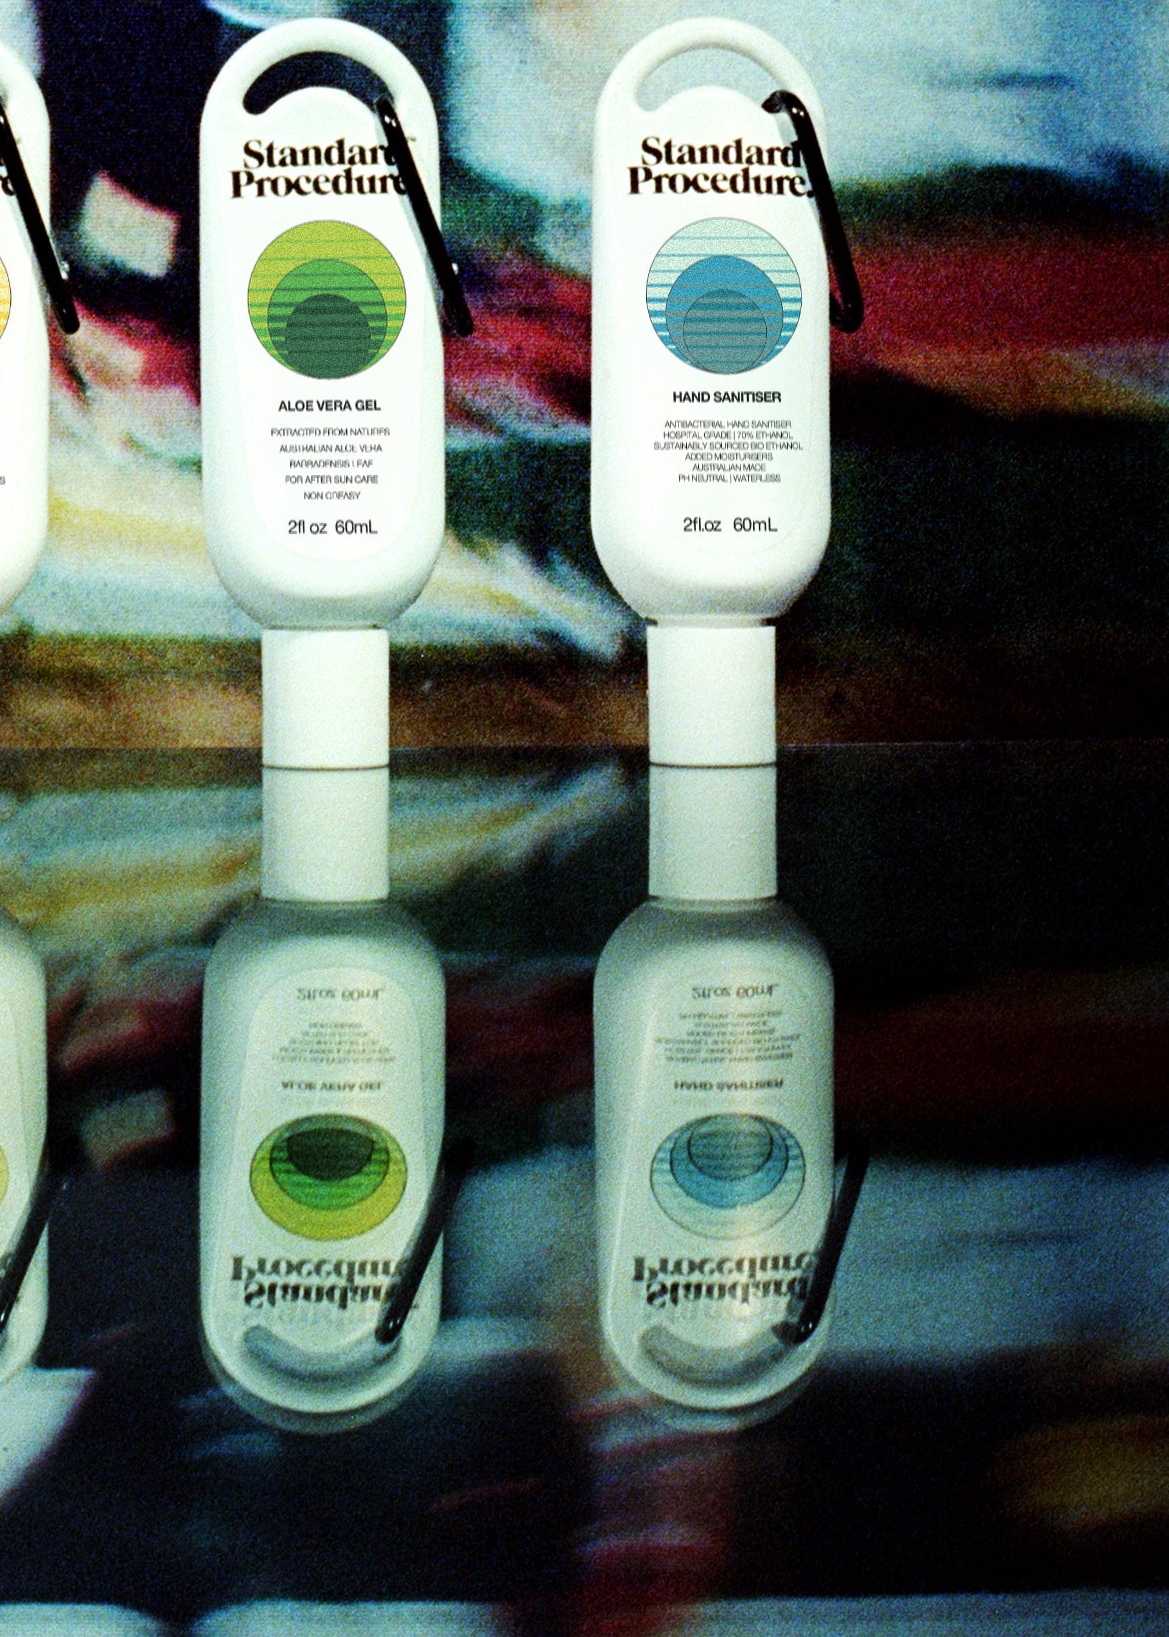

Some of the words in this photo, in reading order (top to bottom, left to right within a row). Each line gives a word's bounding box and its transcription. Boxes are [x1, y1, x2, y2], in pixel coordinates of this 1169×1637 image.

[641, 136, 801, 167] Standard
[673, 391, 710, 403] HAND
[714, 391, 781, 403] SANITISER
[278, 400, 313, 412] ALOE
[316, 399, 352, 411] VERA
[355, 399, 381, 411] GEL
[665, 420, 725, 428] ANTIBACTERIAL
[727, 420, 749, 428] HAND
[752, 420, 791, 429] SANITISER
[271, 428, 321, 436] EXTRACTED
[323, 428, 348, 436] FROM
[350, 427, 390, 436] NATURES
[664, 431, 702, 439] HOSPITAL
[704, 431, 731, 439] GRADE
[738, 431, 754, 439] 70%
[756, 431, 793, 439] ETHANOL
[280, 445, 332, 453] AUSTRALIAN
[335, 444, 356, 452] ALOE
[360, 444, 382, 452] VERA
[654, 442, 707, 450] SUSTAINABLY
[710, 442, 749, 450] SOURCED
[751, 442, 764, 450] BIO
[766, 441, 803, 450] ETHANOL
[685, 453, 713, 461] ADDED
[714, 453, 773, 461] MOISTURISERS
[693, 463, 741, 471] AUSTRALIAN
[743, 463, 766, 471] MADE
[285, 475, 303, 484] FOR
[305, 475, 332, 484] AFTER
[334, 475, 353, 484] SUN
[355, 475, 378, 484] CARE
[679, 474, 690, 482] PH
[692, 474, 727, 482] NEUTRAL
[733, 474, 781, 483] WATERLESS
[304, 491, 323, 500] NON
[325, 491, 360, 500] GREASY
[288, 520, 305, 534] 2fl
[310, 523, 327, 535] oz
[335, 519, 378, 535] 60mL
[684, 517, 722, 532] 2fl.oz
[733, 517, 778, 532] 60mL
